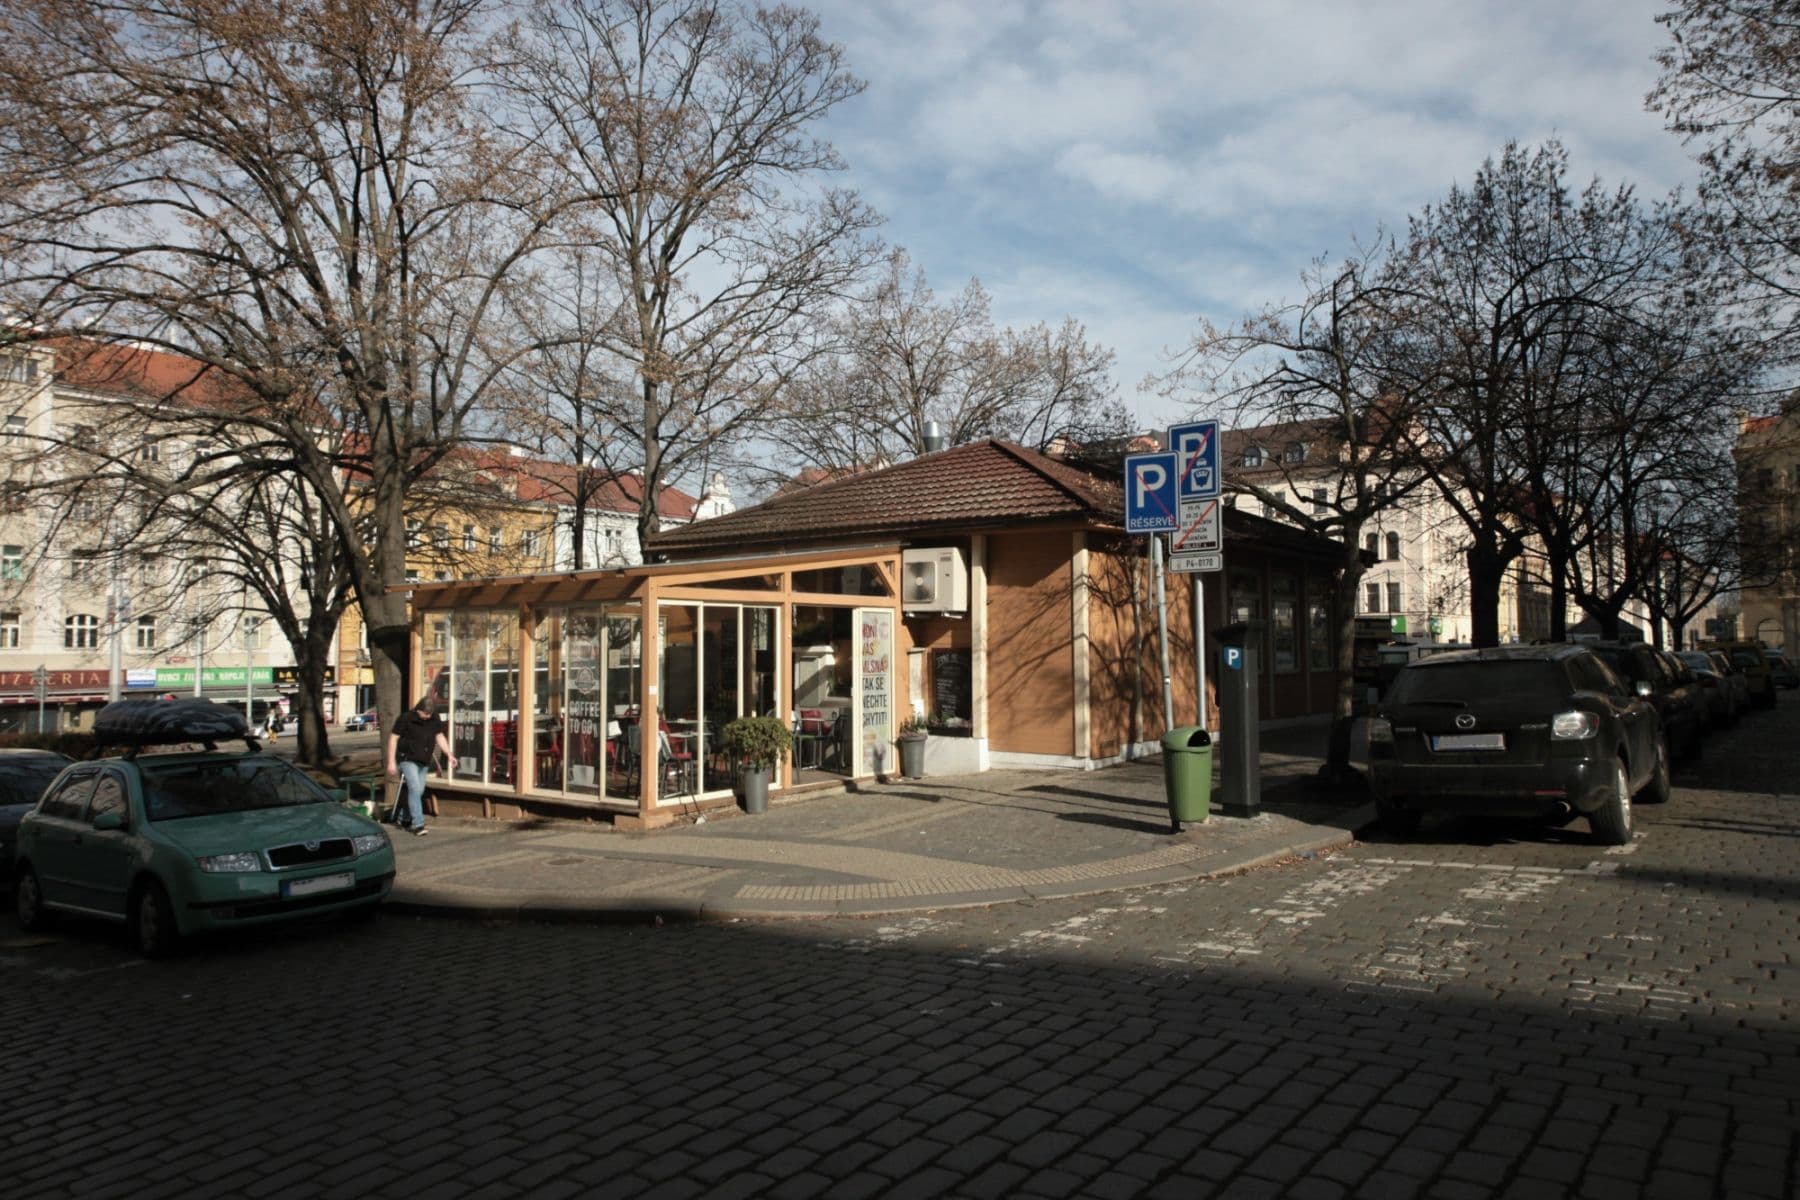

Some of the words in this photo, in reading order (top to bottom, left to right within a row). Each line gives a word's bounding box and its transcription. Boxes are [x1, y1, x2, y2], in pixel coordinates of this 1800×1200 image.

[1179, 432, 1207, 477] P
[1136, 464, 1167, 508] P
[1228, 649, 1239, 666] P
[876, 676, 884, 690] SE
[569, 701, 600, 717] COFFEE
[570, 719, 580, 733] TO
[581, 719, 592, 734] GO
